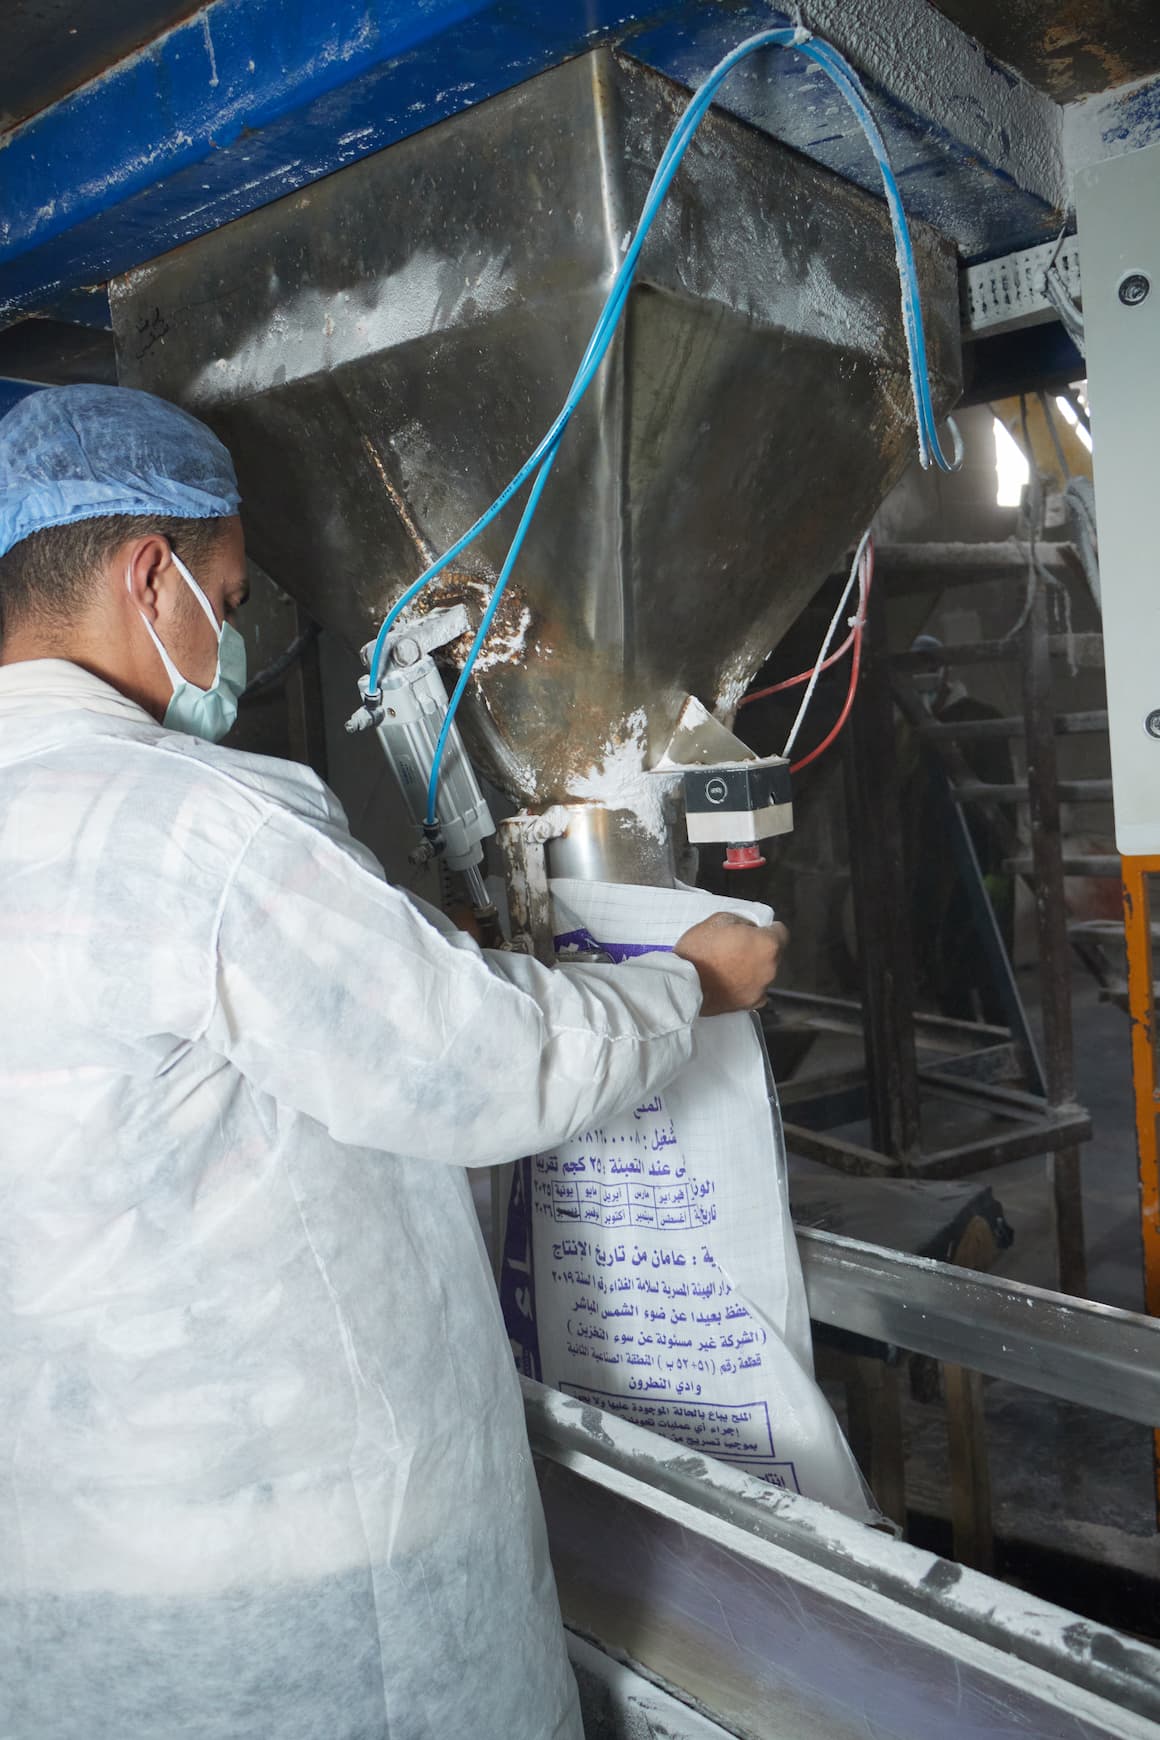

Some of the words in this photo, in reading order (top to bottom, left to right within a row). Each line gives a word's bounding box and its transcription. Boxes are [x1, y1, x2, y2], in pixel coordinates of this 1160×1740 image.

[562, 1156, 586, 1176] كجم
[609, 1158, 643, 1178] التعبئة
[649, 1160, 671, 1176] عند
[595, 1243, 625, 1267] تاريخ
[632, 1245, 648, 1266] من
[651, 1249, 687, 1268] عامان
[610, 1277, 634, 1294] الغذاء
[661, 1280, 690, 1299] المصرية
[691, 1280, 715, 1299] الهيئة
[572, 1296, 599, 1314] المباشر
[601, 1302, 638, 1319] الشمس
[644, 1306, 665, 1323] ضوء
[670, 1308, 687, 1325] عن
[691, 1310, 721, 1326] بعيدا
[614, 1333, 633, 1345] سوء
[637, 1331, 654, 1346] عن
[698, 1335, 717, 1351] غير
[626, 1352, 654, 1367] المنطقة
[719, 1358, 737, 1375] رقم
[739, 1353, 762, 1370] قطعة
[628, 1375, 671, 1391] النطرون
[675, 1380, 702, 1396] وادي
